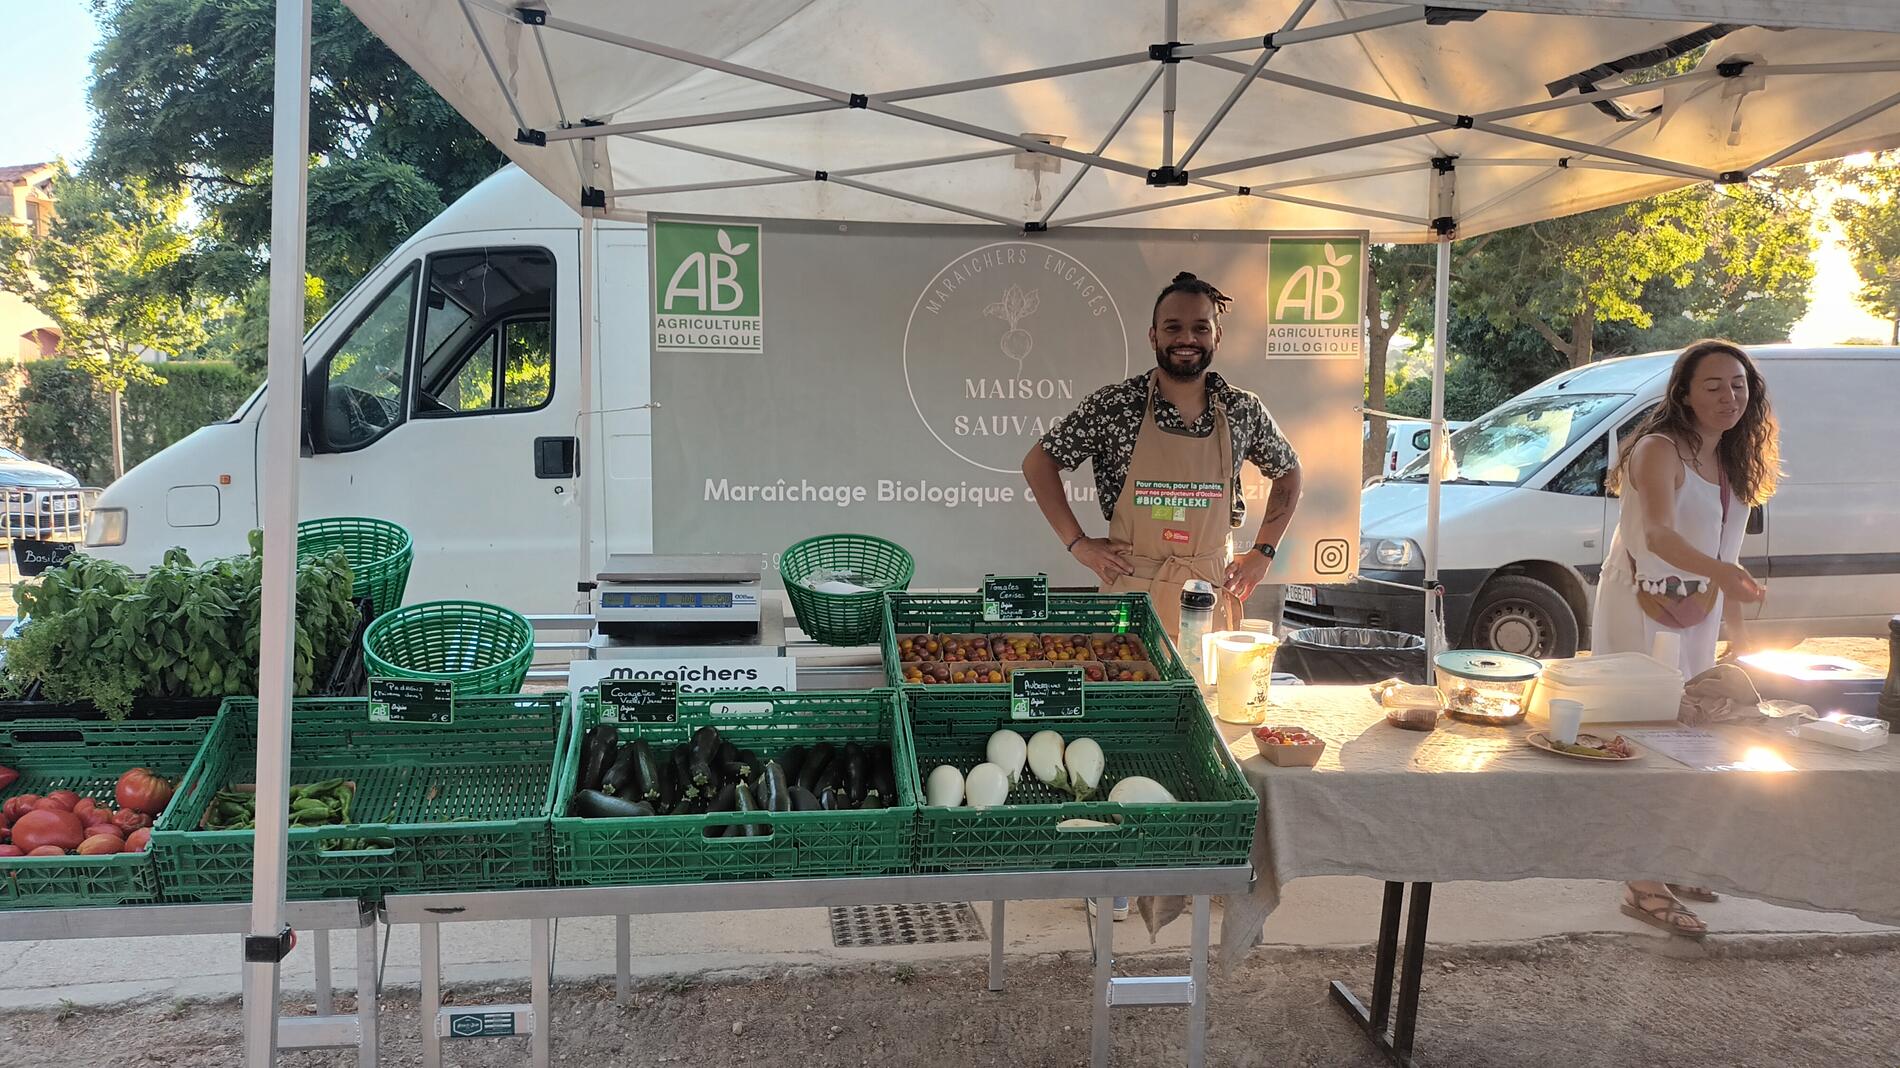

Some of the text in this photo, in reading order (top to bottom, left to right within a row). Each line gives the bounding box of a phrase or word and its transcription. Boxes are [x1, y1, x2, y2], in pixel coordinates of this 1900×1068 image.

[663, 251, 744, 311] AB
[1275, 264, 1345, 321] AB
[657, 318, 760, 331] AGRICULTURE
[1268, 327, 1359, 338] AGRICULTURE
[658, 333, 760, 346] BIOLOGIQUE
[1268, 342, 1359, 352] BIOLOGIQUE
[965, 378, 1073, 400] MAISON
[1135, 480, 1152, 488] Pour
[1173, 483, 1189, 491] pour
[1190, 482, 1198, 490] la
[703, 478, 867, 508] Maraîchage
[877, 479, 1014, 508] Biologique
[1136, 496, 1208, 507] #BIO RÉFLEXE
[989, 582, 1020, 591] Tomates
[1038, 609, 1045, 618] €
[440, 714, 449, 722] €
[666, 714, 674, 722] €
